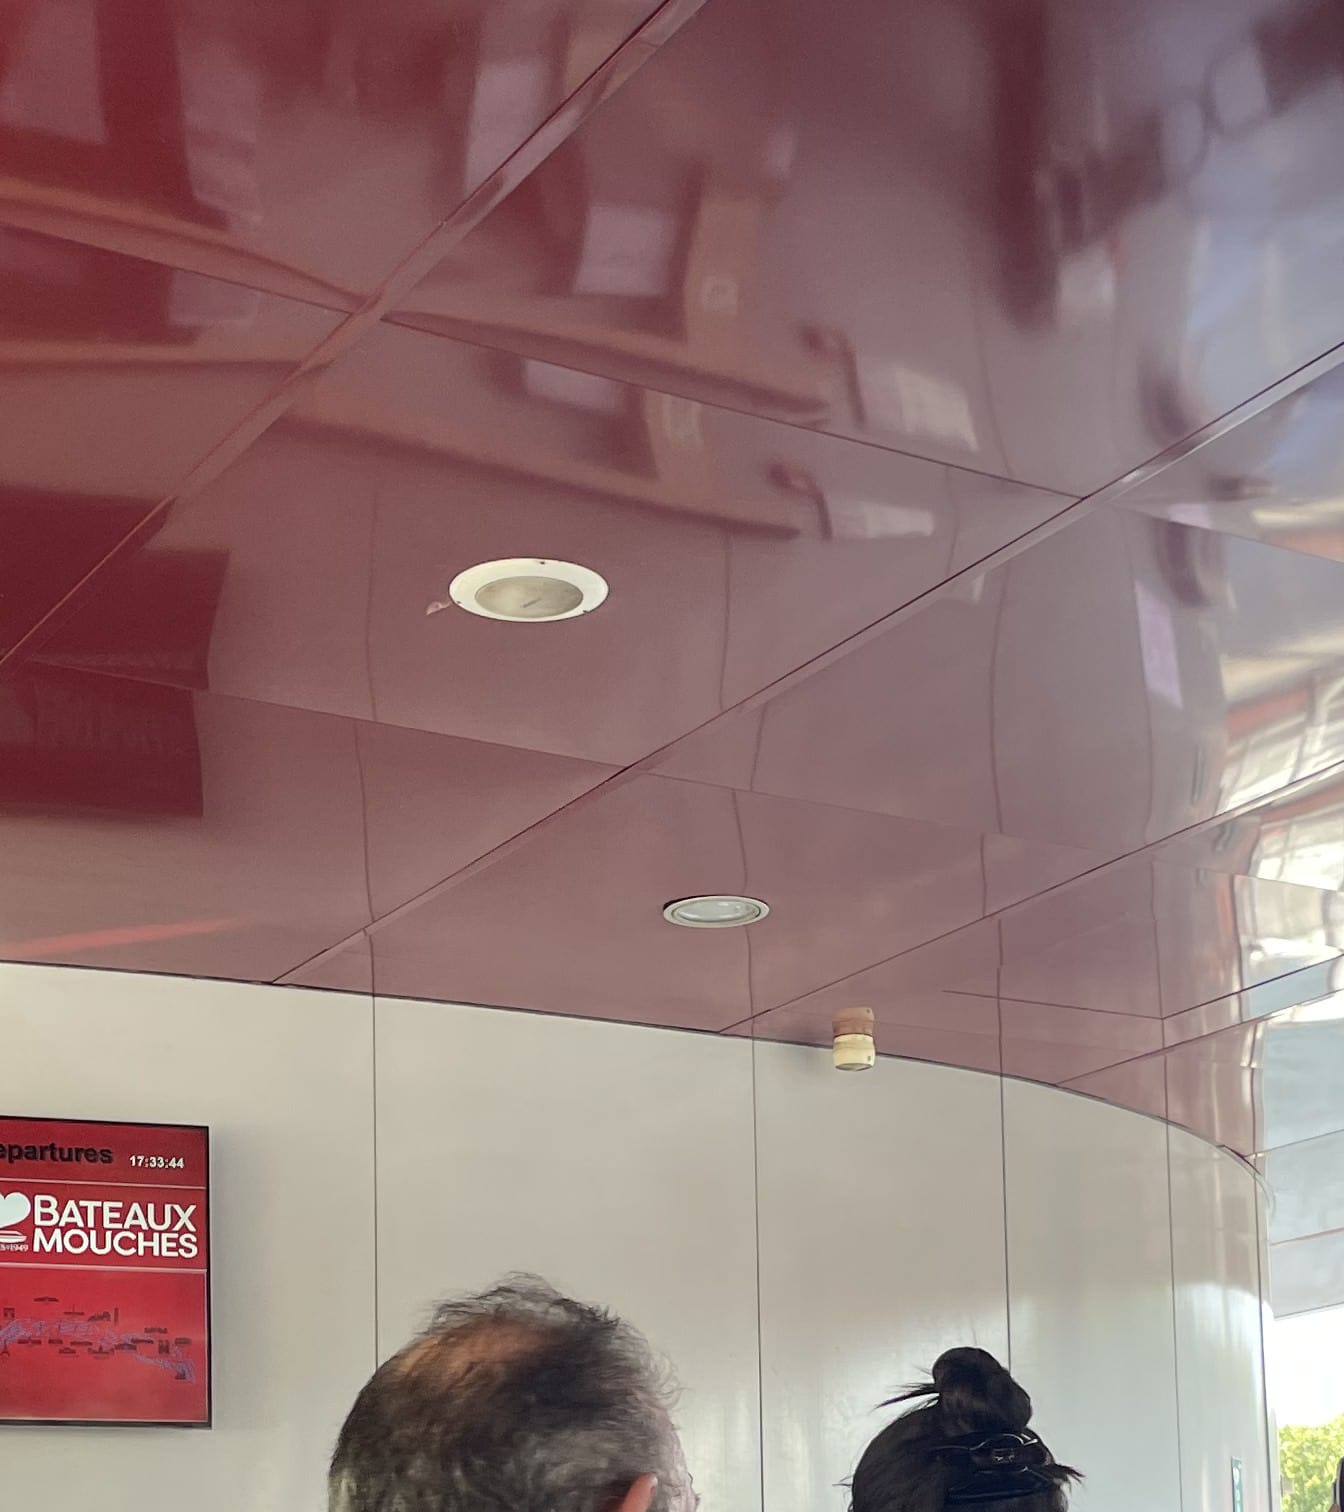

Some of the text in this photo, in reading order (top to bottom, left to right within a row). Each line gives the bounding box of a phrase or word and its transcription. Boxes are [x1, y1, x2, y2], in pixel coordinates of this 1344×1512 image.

[129, 1155, 185, 1169] 17:33:44
[33, 1194, 197, 1232] BATEAUX
[32, 1227, 198, 1259] MOUCHES
